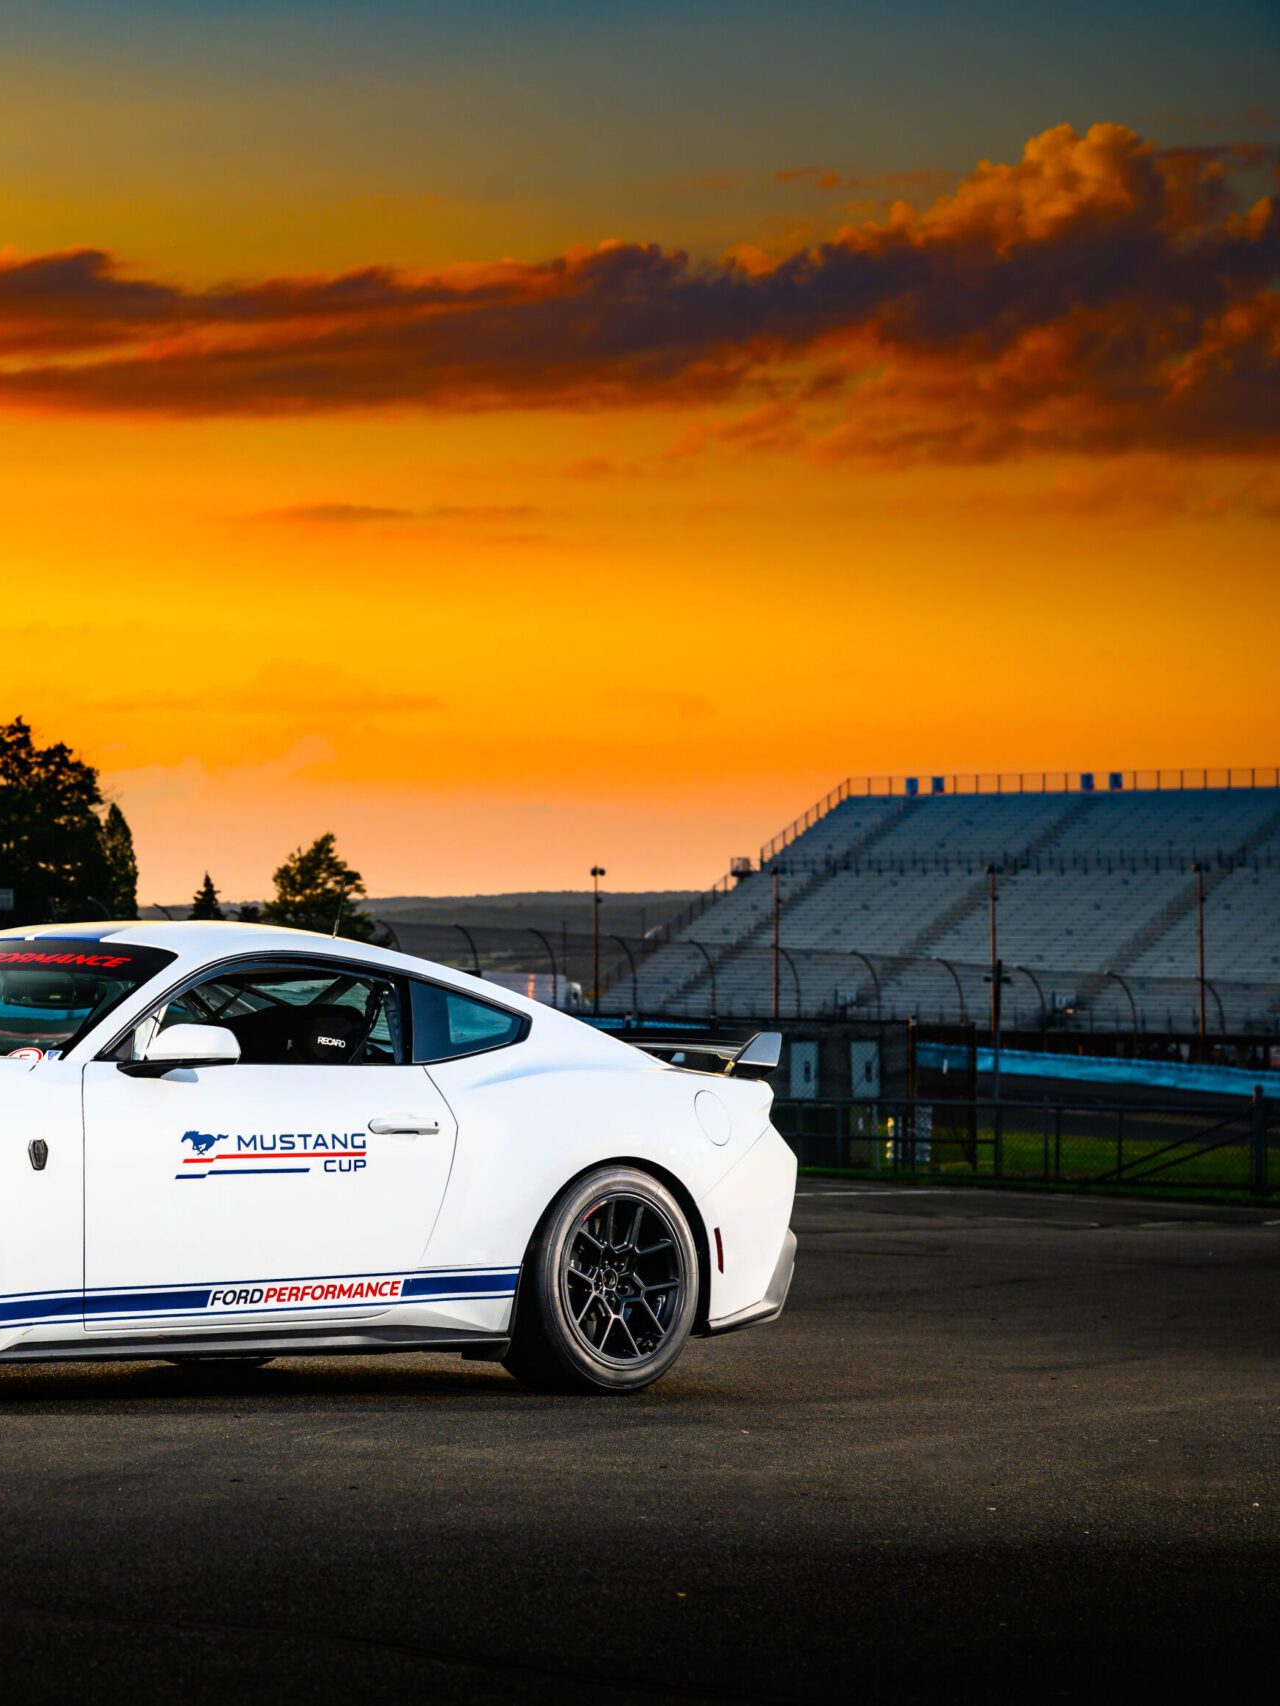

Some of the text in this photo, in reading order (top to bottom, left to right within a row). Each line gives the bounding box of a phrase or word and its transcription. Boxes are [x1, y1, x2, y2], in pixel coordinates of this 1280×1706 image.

[317, 1036, 346, 1049] RECARO
[237, 1133, 367, 1151] MUSTANG
[324, 1159, 367, 1173] CUP
